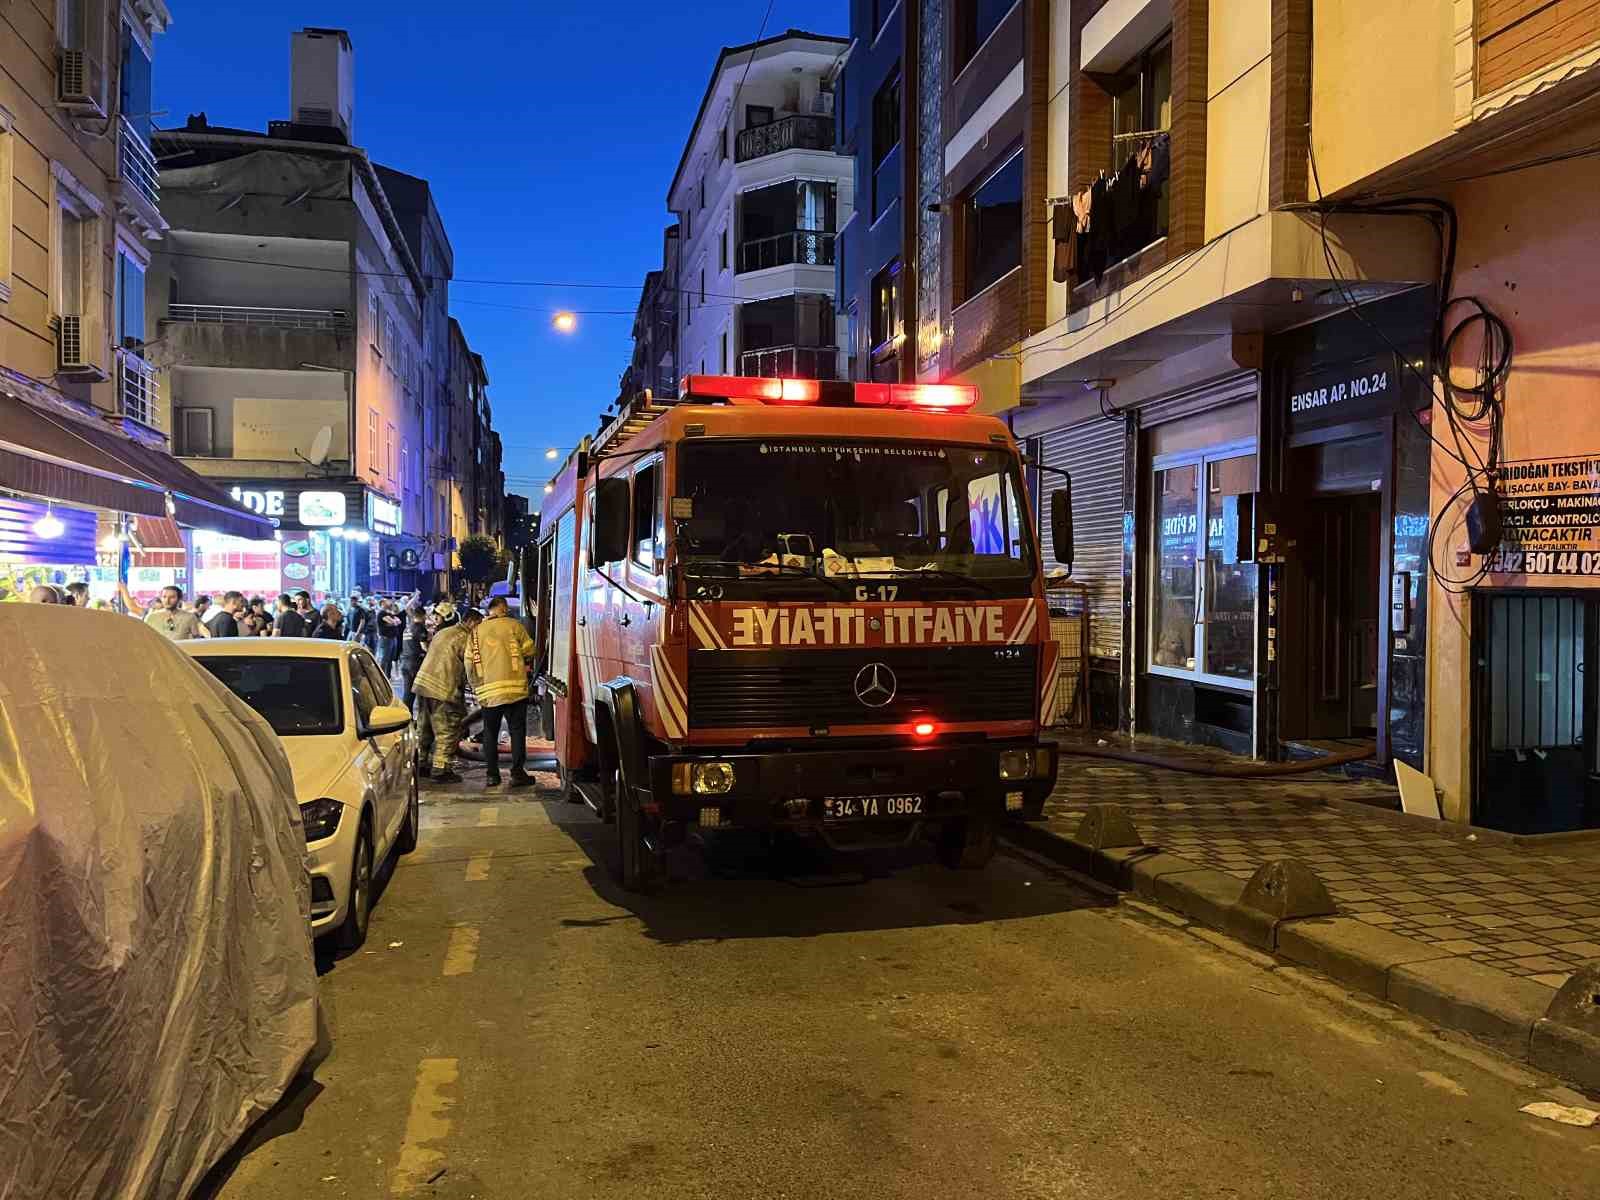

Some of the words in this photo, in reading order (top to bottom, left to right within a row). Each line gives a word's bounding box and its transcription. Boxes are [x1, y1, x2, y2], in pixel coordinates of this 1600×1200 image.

[1291, 388, 1328, 412] ENSAR
[1330, 383, 1347, 403] AP.
[1350, 371, 1387, 398] NO.24
[1525, 552, 1555, 573] 501
[1556, 551, 1578, 573] 44
[856, 585, 898, 601] G-17
[884, 606, 1004, 644] İTFAİYE
[835, 799, 853, 817] 34
[862, 798, 879, 816] YA
[887, 796, 922, 814] 0962
